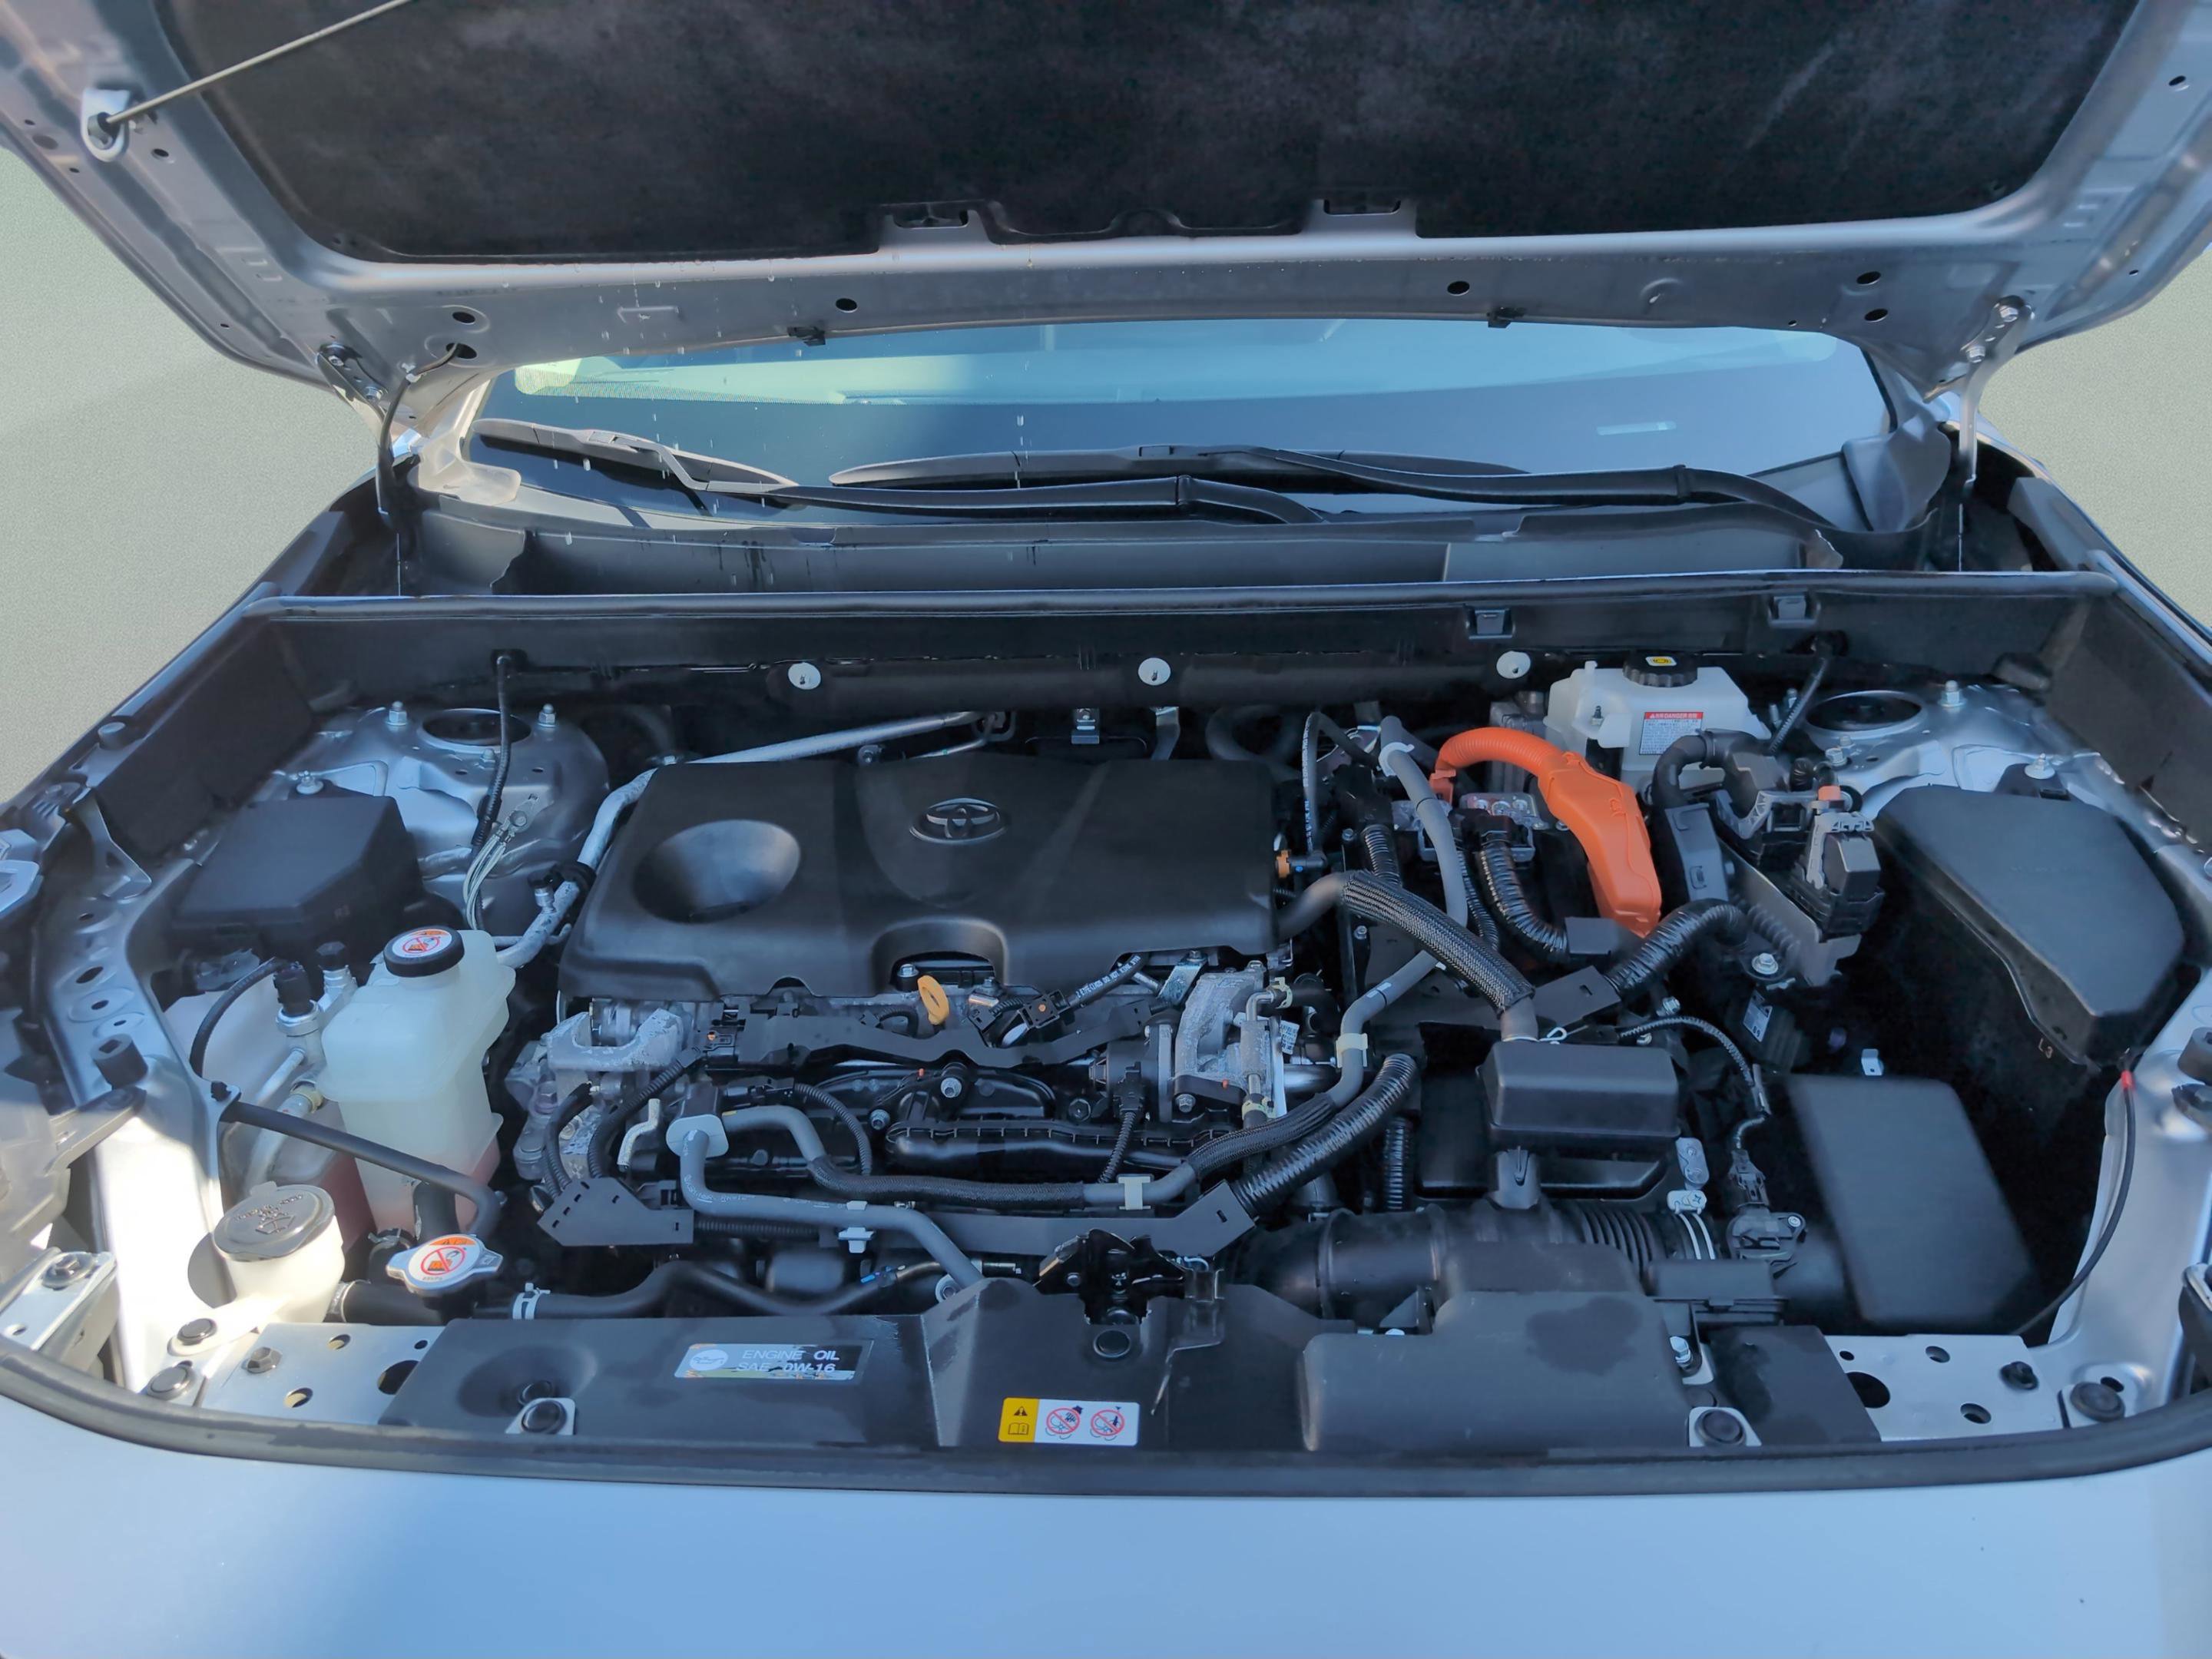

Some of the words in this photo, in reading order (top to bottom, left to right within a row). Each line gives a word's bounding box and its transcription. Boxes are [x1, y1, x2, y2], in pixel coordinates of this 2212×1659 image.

[742, 1349, 804, 1359] ENGINE
[813, 1349, 840, 1361] OIL
[735, 1362, 770, 1372] SAE
[782, 1362, 836, 1373] 0W-16
